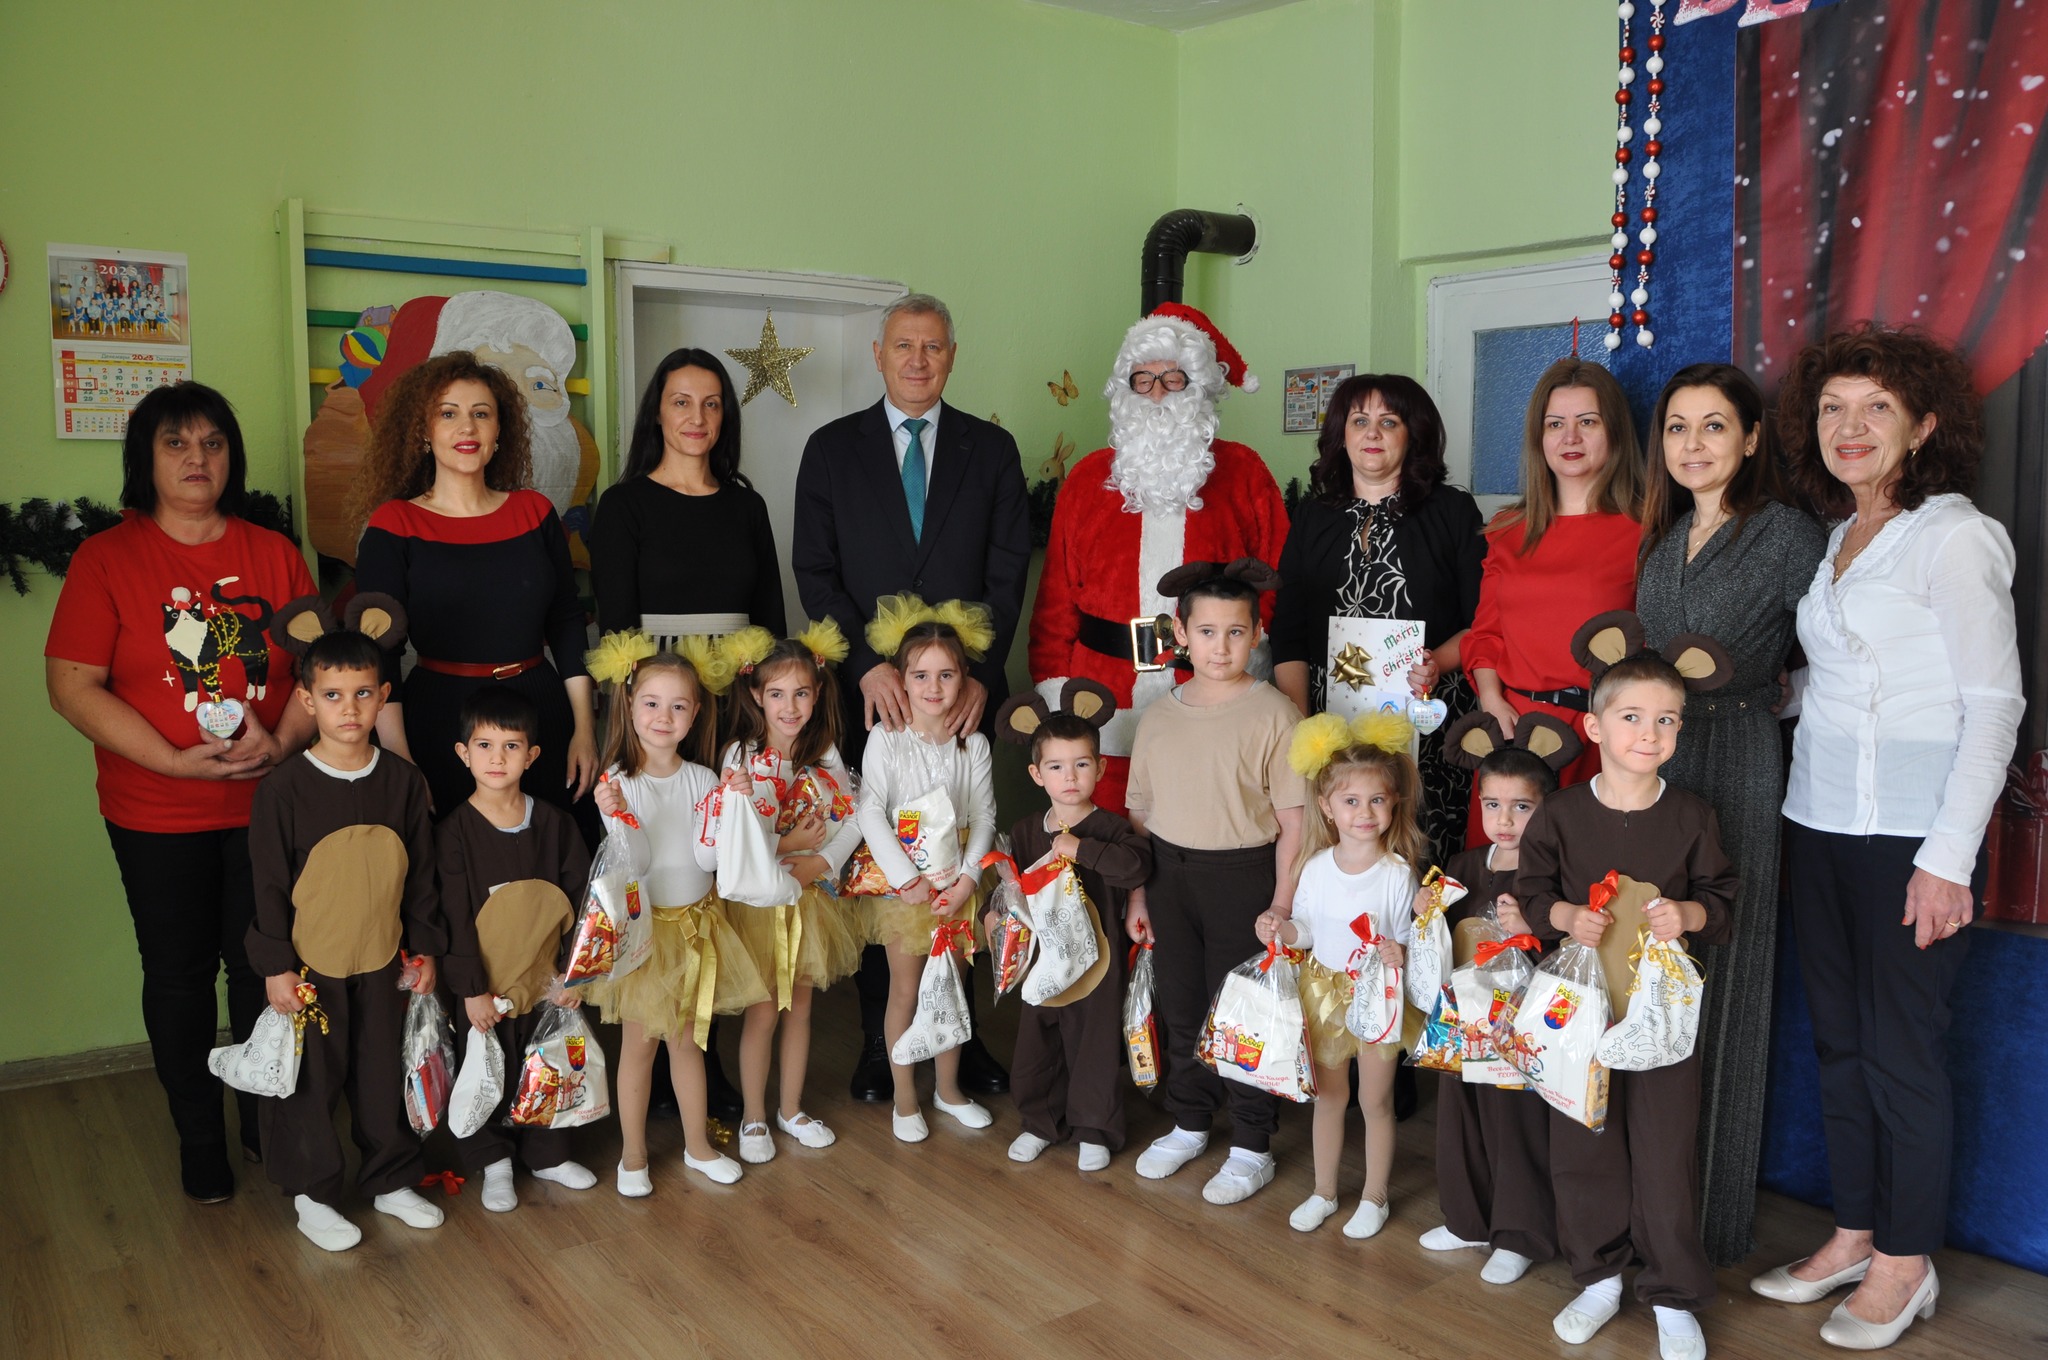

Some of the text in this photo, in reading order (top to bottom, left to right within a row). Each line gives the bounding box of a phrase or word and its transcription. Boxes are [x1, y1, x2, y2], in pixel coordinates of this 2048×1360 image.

[99, 264, 138, 276] 202
[1384, 623, 1420, 650] Merry
[933, 1009, 958, 1024] HO
